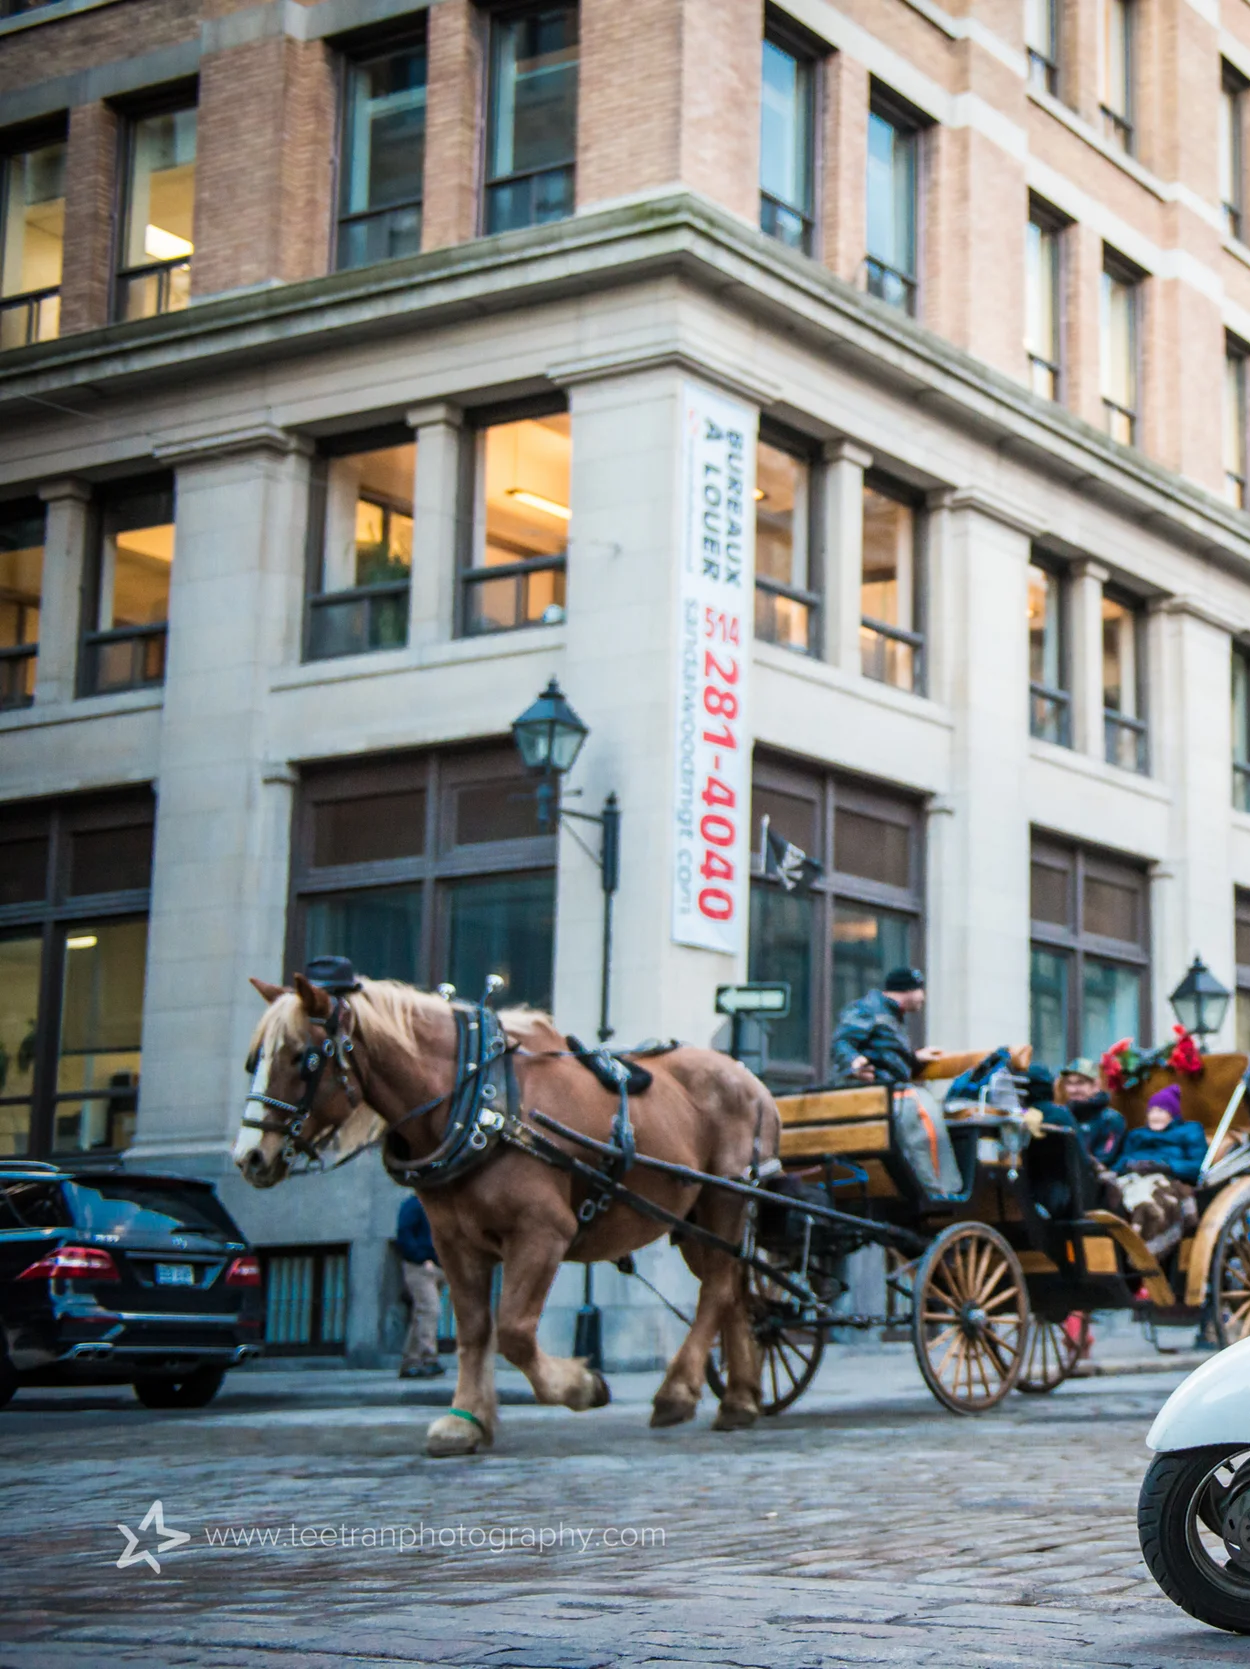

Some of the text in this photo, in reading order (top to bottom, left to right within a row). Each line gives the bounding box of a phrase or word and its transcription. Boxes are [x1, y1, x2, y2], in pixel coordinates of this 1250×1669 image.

[701, 462, 722, 582] LOUER
[725, 428, 744, 588] BUREAUX
[704, 607, 740, 648] 514
[698, 650, 739, 921] 281-4040
